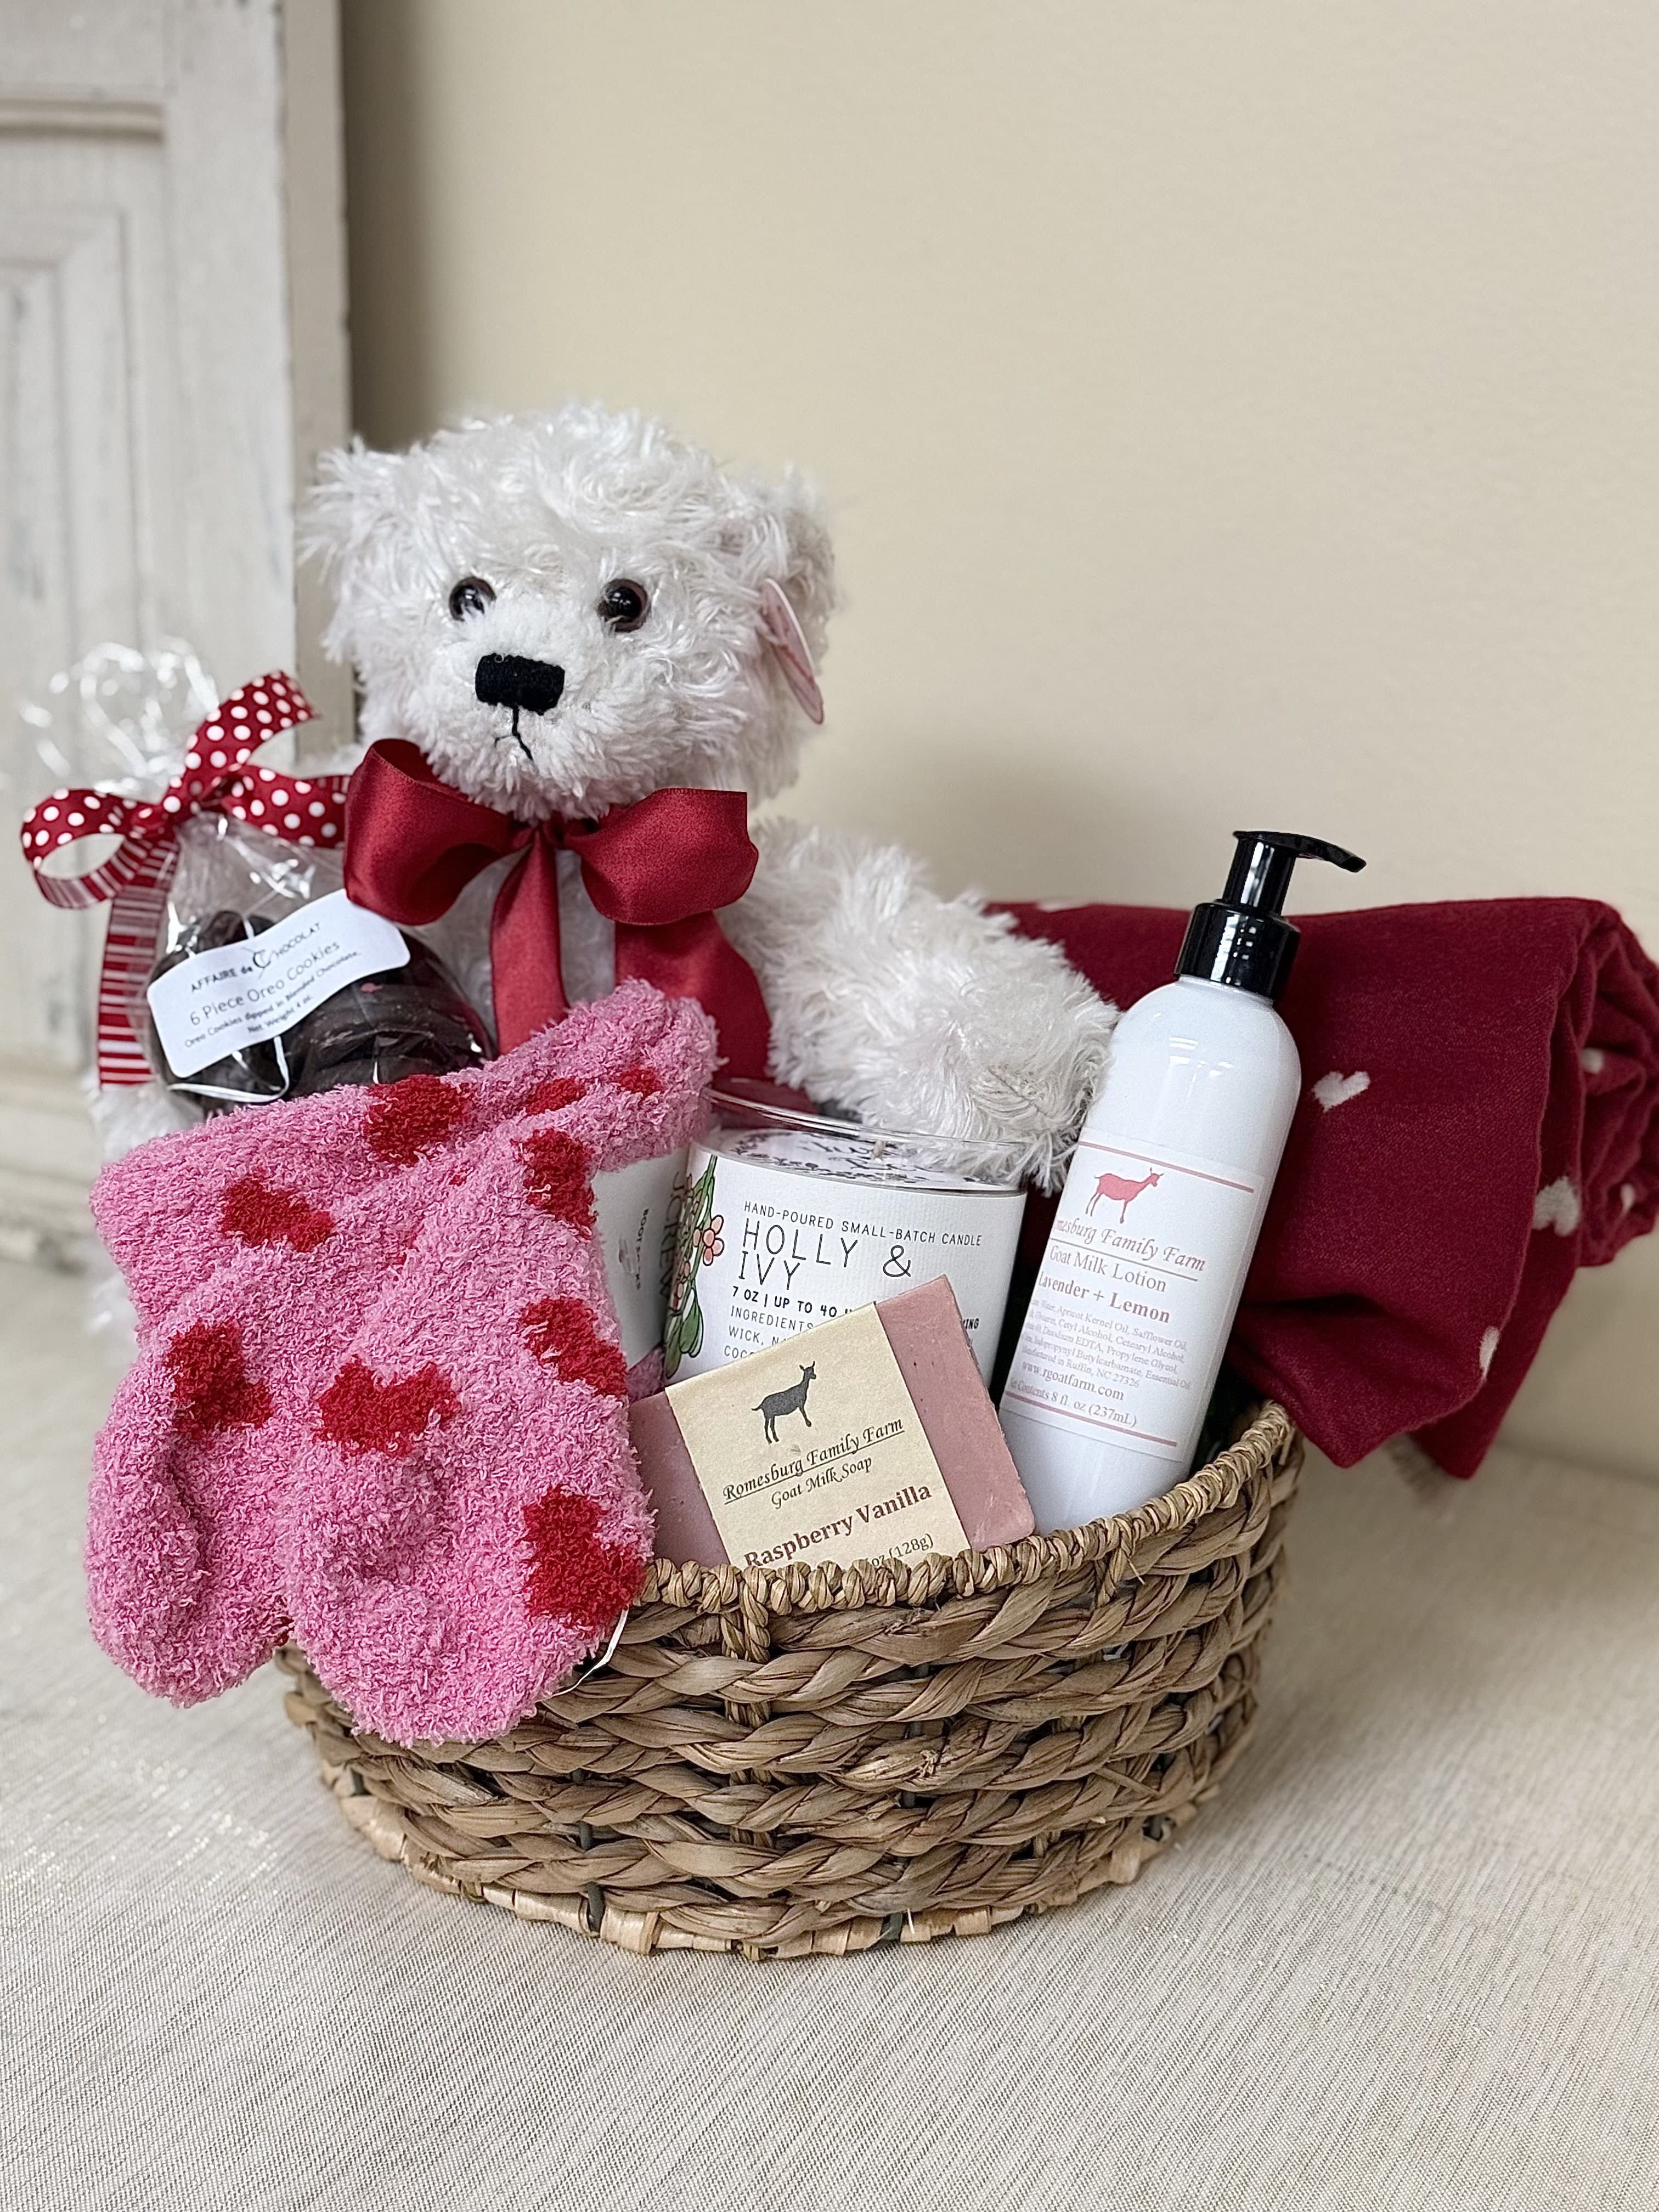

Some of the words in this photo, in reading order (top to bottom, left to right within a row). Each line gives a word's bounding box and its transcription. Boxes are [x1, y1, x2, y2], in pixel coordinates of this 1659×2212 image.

[191, 968, 237, 993] AFFAIRE
[253, 922, 320, 970] CHOCOLAT
[190, 1011, 200, 1026] 6
[203, 996, 245, 1019] Piece
[247, 980, 285, 1002] Oreo
[287, 941, 340, 980] Cookies
[185, 1034, 206, 1047] Oreo
[208, 1017, 242, 1035] Cookies
[276, 1000, 284, 1008] in
[247, 1024, 263, 1033] Net
[264, 1007, 295, 1026] Weight
[636, 1209, 649, 1242] BOOT
[743, 1200, 834, 1229] HAND-POURED
[842, 1220, 935, 1244] SMALL-BATCH
[941, 1233, 983, 1246] CANDLE
[743, 1218, 858, 1268] HOLLY
[882, 1244, 911, 1278] &
[1101, 1228, 1159, 1261] Family
[1163, 1246, 1206, 1272] Farm
[738, 1250, 800, 1290] IVY
[1049, 1245, 1071, 1265] Goat
[1073, 1251, 1108, 1276] Milk
[1111, 1263, 1167, 1293] Lotion
[732, 1285, 739, 1297] 7
[744, 1289, 759, 1303] OZ
[774, 1295, 790, 1309] UP
[798, 1300, 813, 1313] TO
[820, 1304, 837, 1318] 40
[1038, 1271, 1090, 1300] Lavender
[1109, 1291, 1170, 1324] Lemon
[729, 1324, 764, 1346] WICK,
[1058, 1306, 1083, 1320] Apricot
[1085, 1313, 1114, 1329] Kernel
[1132, 1328, 1173, 1347] Safflower
[724, 1345, 755, 1359] COC
[1107, 1345, 1150, 1365] Propylene
[1115, 1336, 1152, 1353] Cetearyl
[1153, 1346, 1185, 1364] Alcohol,
[1096, 1368, 1112, 1380] NC
[1112, 1373, 1141, 1388] 27326
[1145, 1369, 1179, 1387] Essential
[1051, 1391, 1058, 1403] 8
[1073, 1401, 1087, 1412] oz
[1088, 1403, 1137, 1427] (237mL)
[723, 1460, 804, 1501] Romesburg
[806, 1434, 860, 1466] Family
[862, 1419, 904, 1443] Farm
[771, 1484, 803, 1510] Goat
[805, 1466, 842, 1493] Milk
[841, 1457, 872, 1477] Soap
[743, 1515, 854, 1567] Raspberry
[855, 1485, 933, 1524] Vanilla
